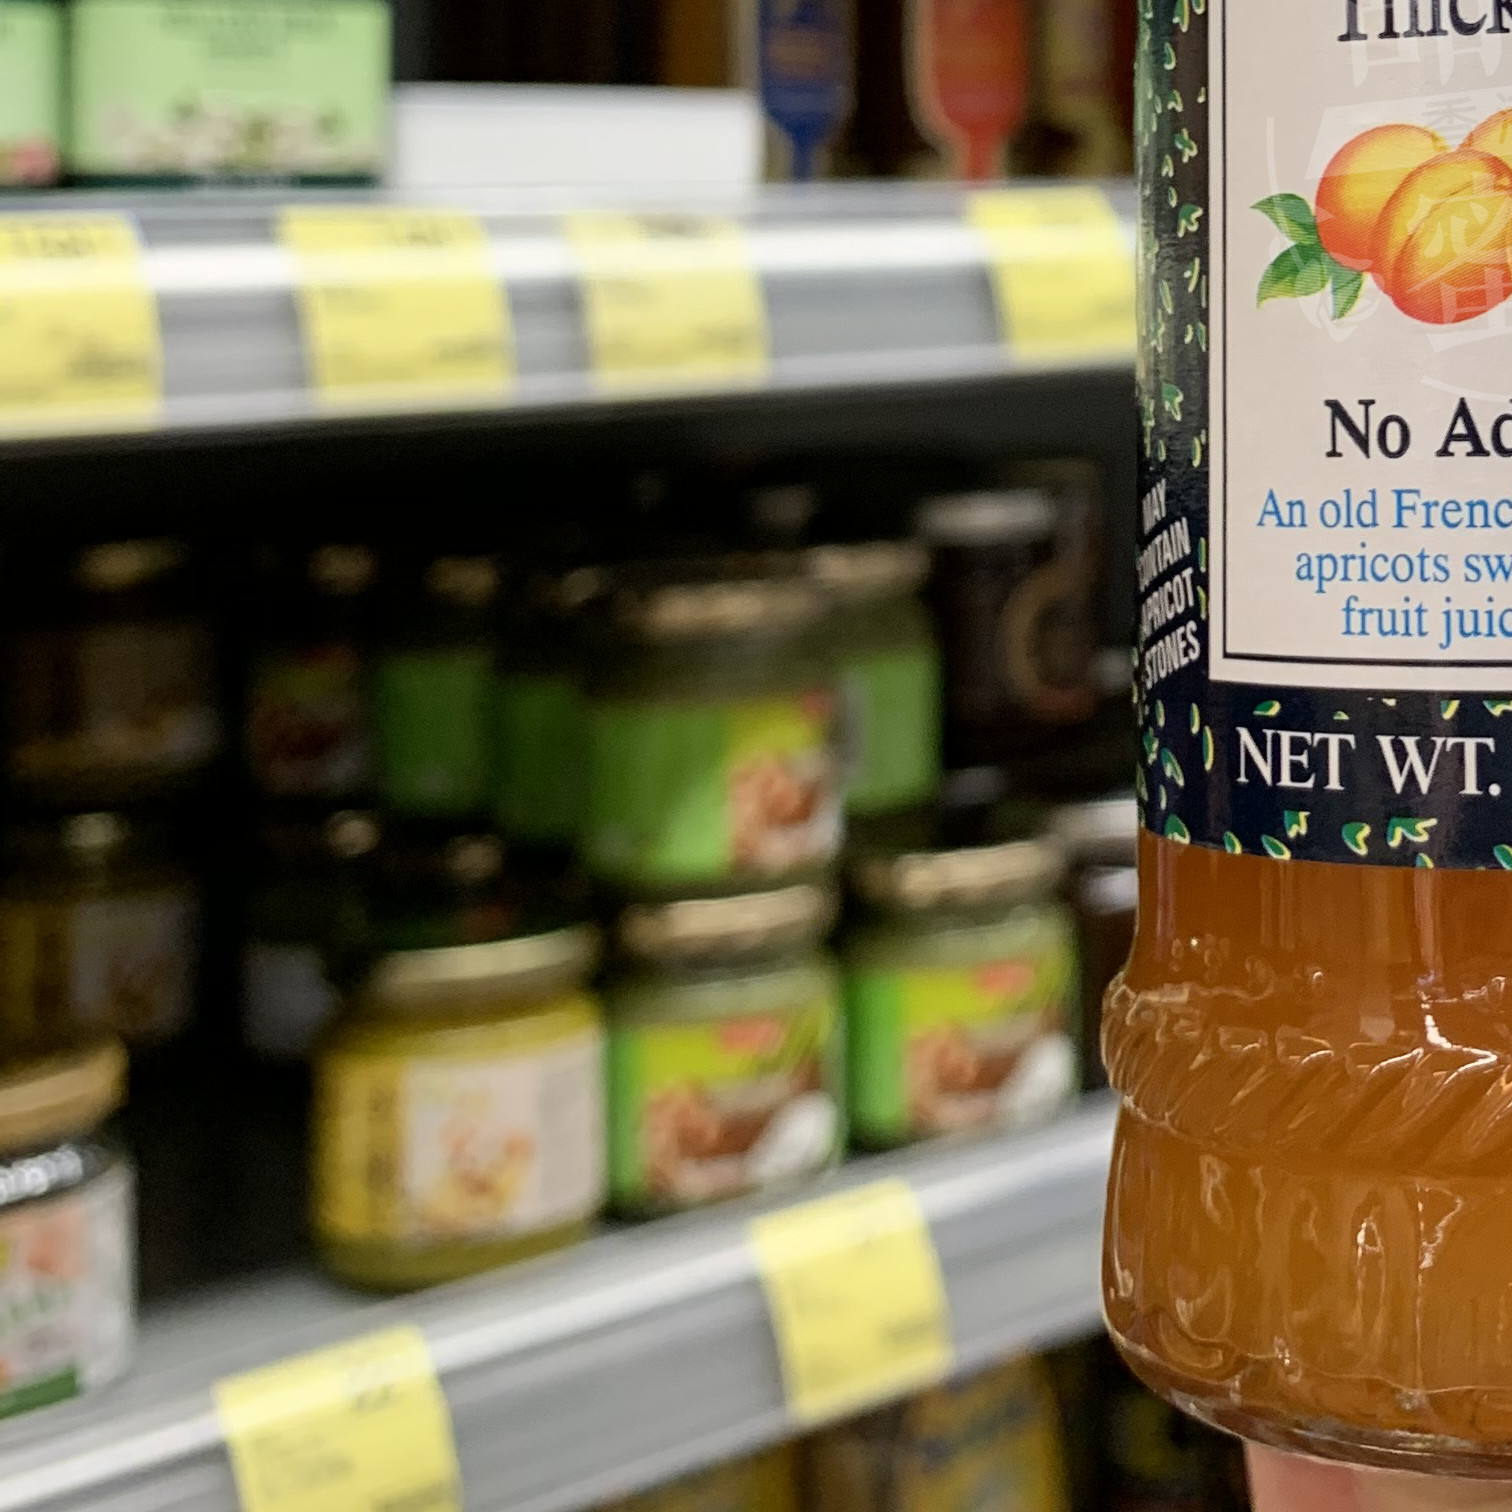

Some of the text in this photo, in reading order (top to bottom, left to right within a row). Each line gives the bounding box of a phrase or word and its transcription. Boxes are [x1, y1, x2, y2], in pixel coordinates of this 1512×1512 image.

[1324, 398, 1412, 459] No
[1257, 490, 1308, 529] An
[1318, 487, 1380, 529] old
[1294, 543, 1452, 594] apricots
[1341, 595, 1428, 639] fruit
[1144, 619, 1201, 691] STONES
[1235, 726, 1356, 792] NET
[1374, 735, 1502, 798] WT.
